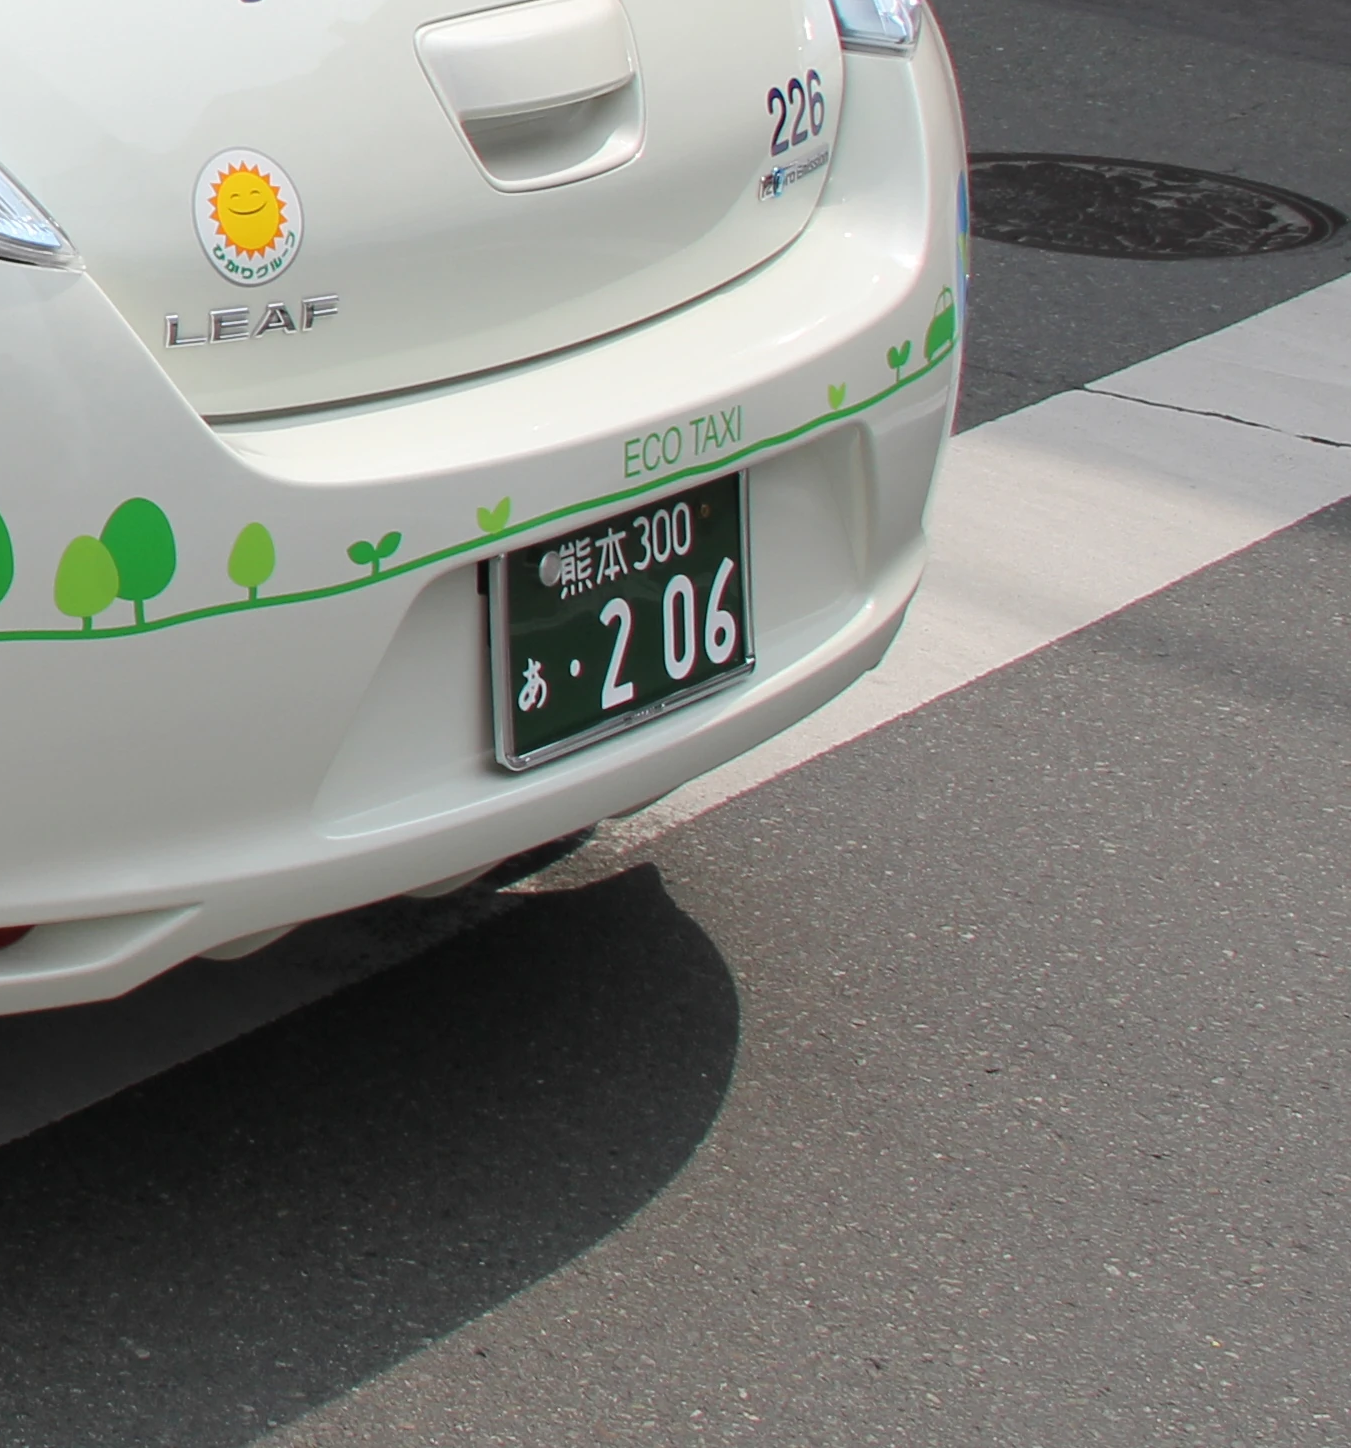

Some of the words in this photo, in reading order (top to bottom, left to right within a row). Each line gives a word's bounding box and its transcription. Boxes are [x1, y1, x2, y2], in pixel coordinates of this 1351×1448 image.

[766, 68, 826, 158] 226
[212, 229, 297, 281] ひかりグループ
[164, 293, 340, 349] LEAF
[623, 425, 683, 479] ECO
[688, 404, 743, 455] TAXI
[517, 657, 548, 713] あ
